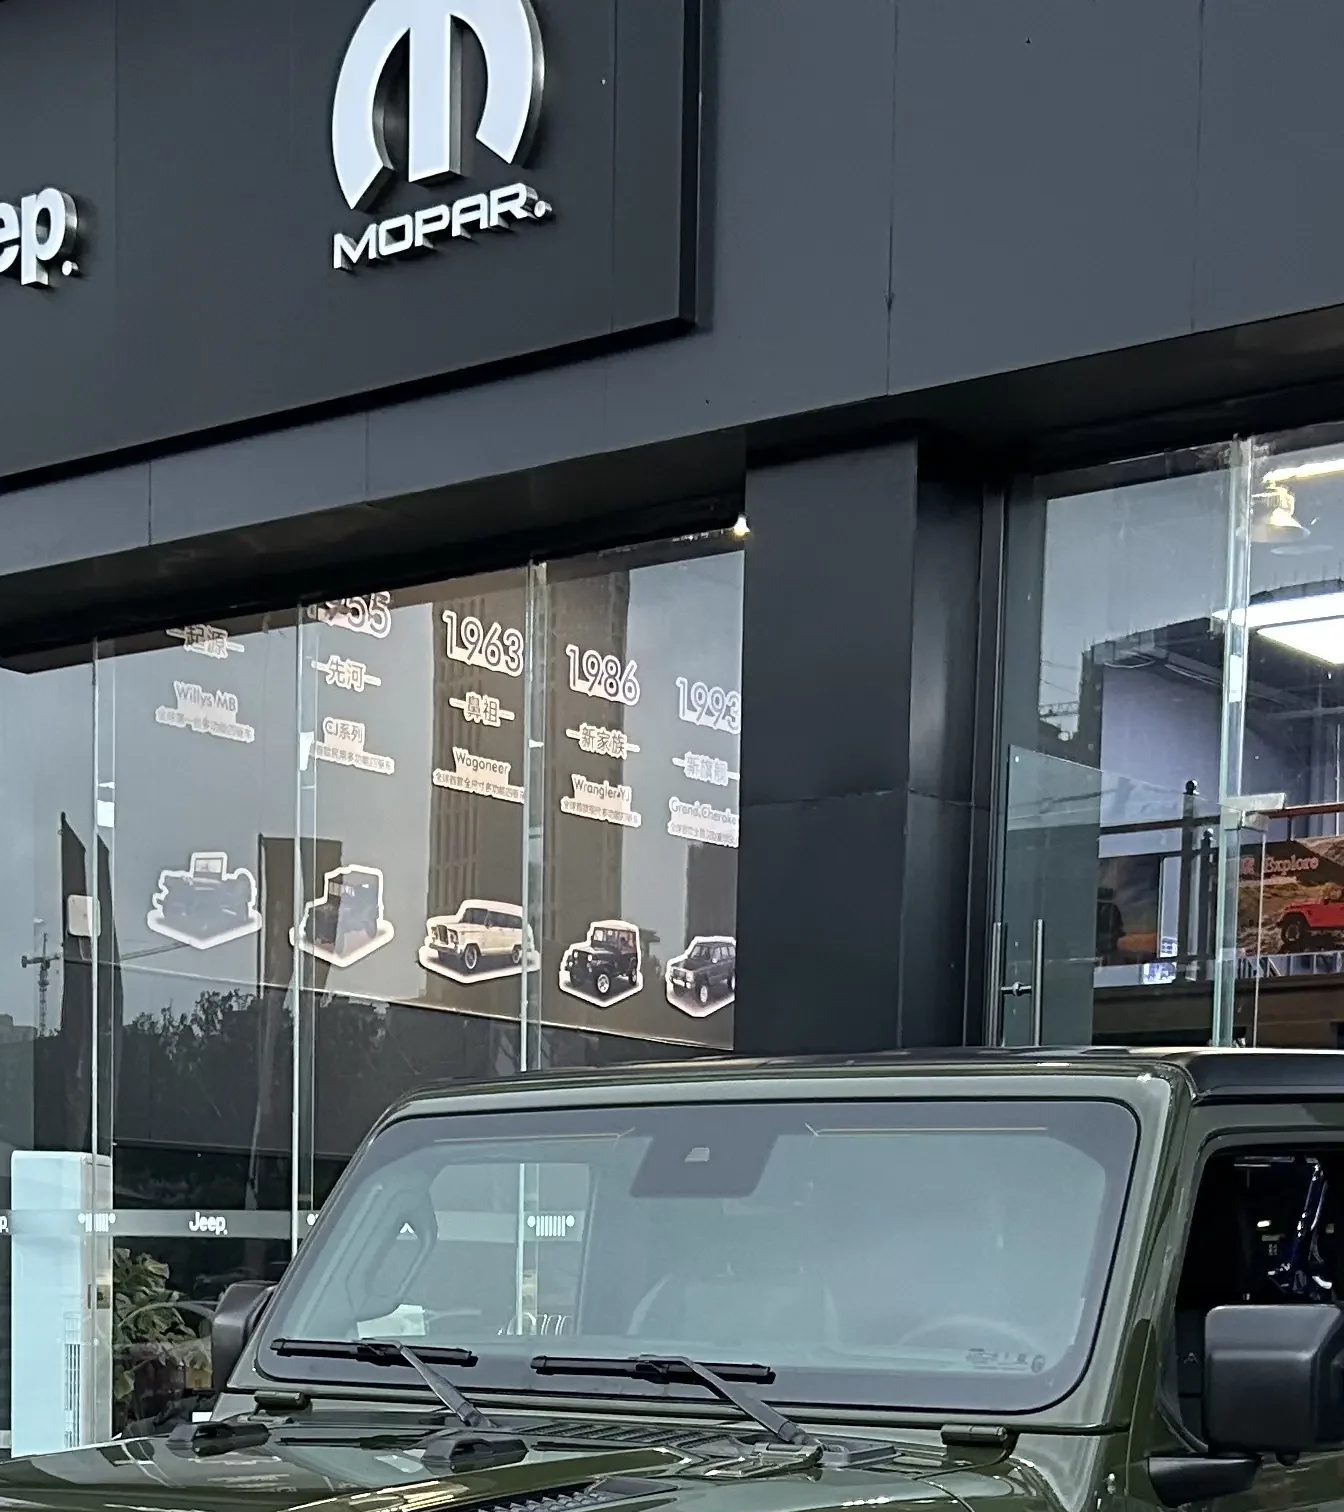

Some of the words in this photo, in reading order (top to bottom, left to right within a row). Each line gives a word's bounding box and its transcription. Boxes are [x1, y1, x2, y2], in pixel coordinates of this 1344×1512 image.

[446, 614, 523, 673] 1963
[329, 657, 364, 689] 先河
[567, 648, 638, 701] 1986
[466, 694, 498, 723] 鼻祖
[678, 679, 741, 731] 1993
[581, 726, 626, 757] 新家族
[455, 751, 510, 775] Wagoneer
[574, 777, 617, 800] Wrangler
